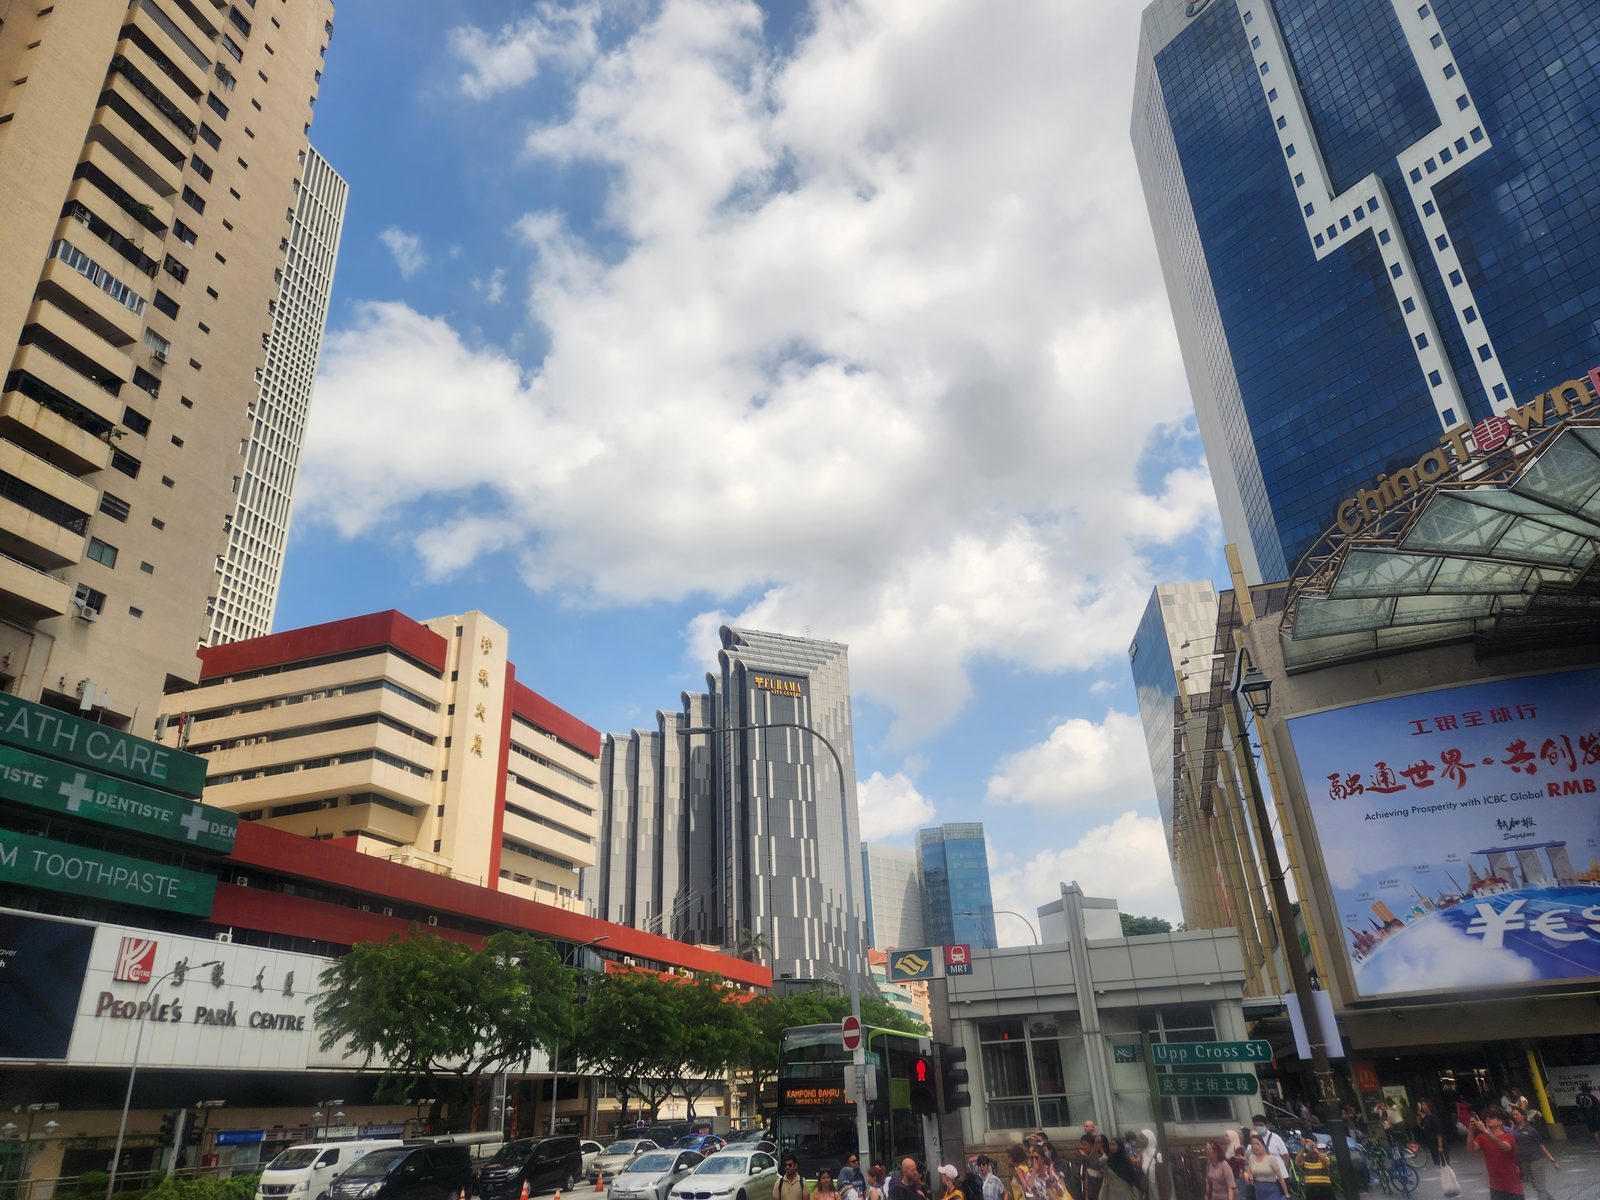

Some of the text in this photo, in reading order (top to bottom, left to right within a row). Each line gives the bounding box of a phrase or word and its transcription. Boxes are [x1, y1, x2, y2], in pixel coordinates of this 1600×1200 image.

[1408, 704, 1538, 736] 工银全球行
[86, 731, 170, 780] CARE
[95, 791, 174, 822] DENTISTE'
[1364, 779, 1597, 821] Achieving Prosperity with ICBC Global RMB
[1503, 832, 1536, 841] Singapore
[33, 850, 180, 898] TOOTHPASTE
[950, 964, 968, 973] MRT
[250, 1011, 305, 1031] CENTRE
[1157, 1043, 1264, 1062] Upp Cross St
[786, 1089, 817, 1098] KAMPONG
[818, 1088, 840, 1097] BAHRU
[1163, 1077, 1250, 1092] 克罗士街上段
